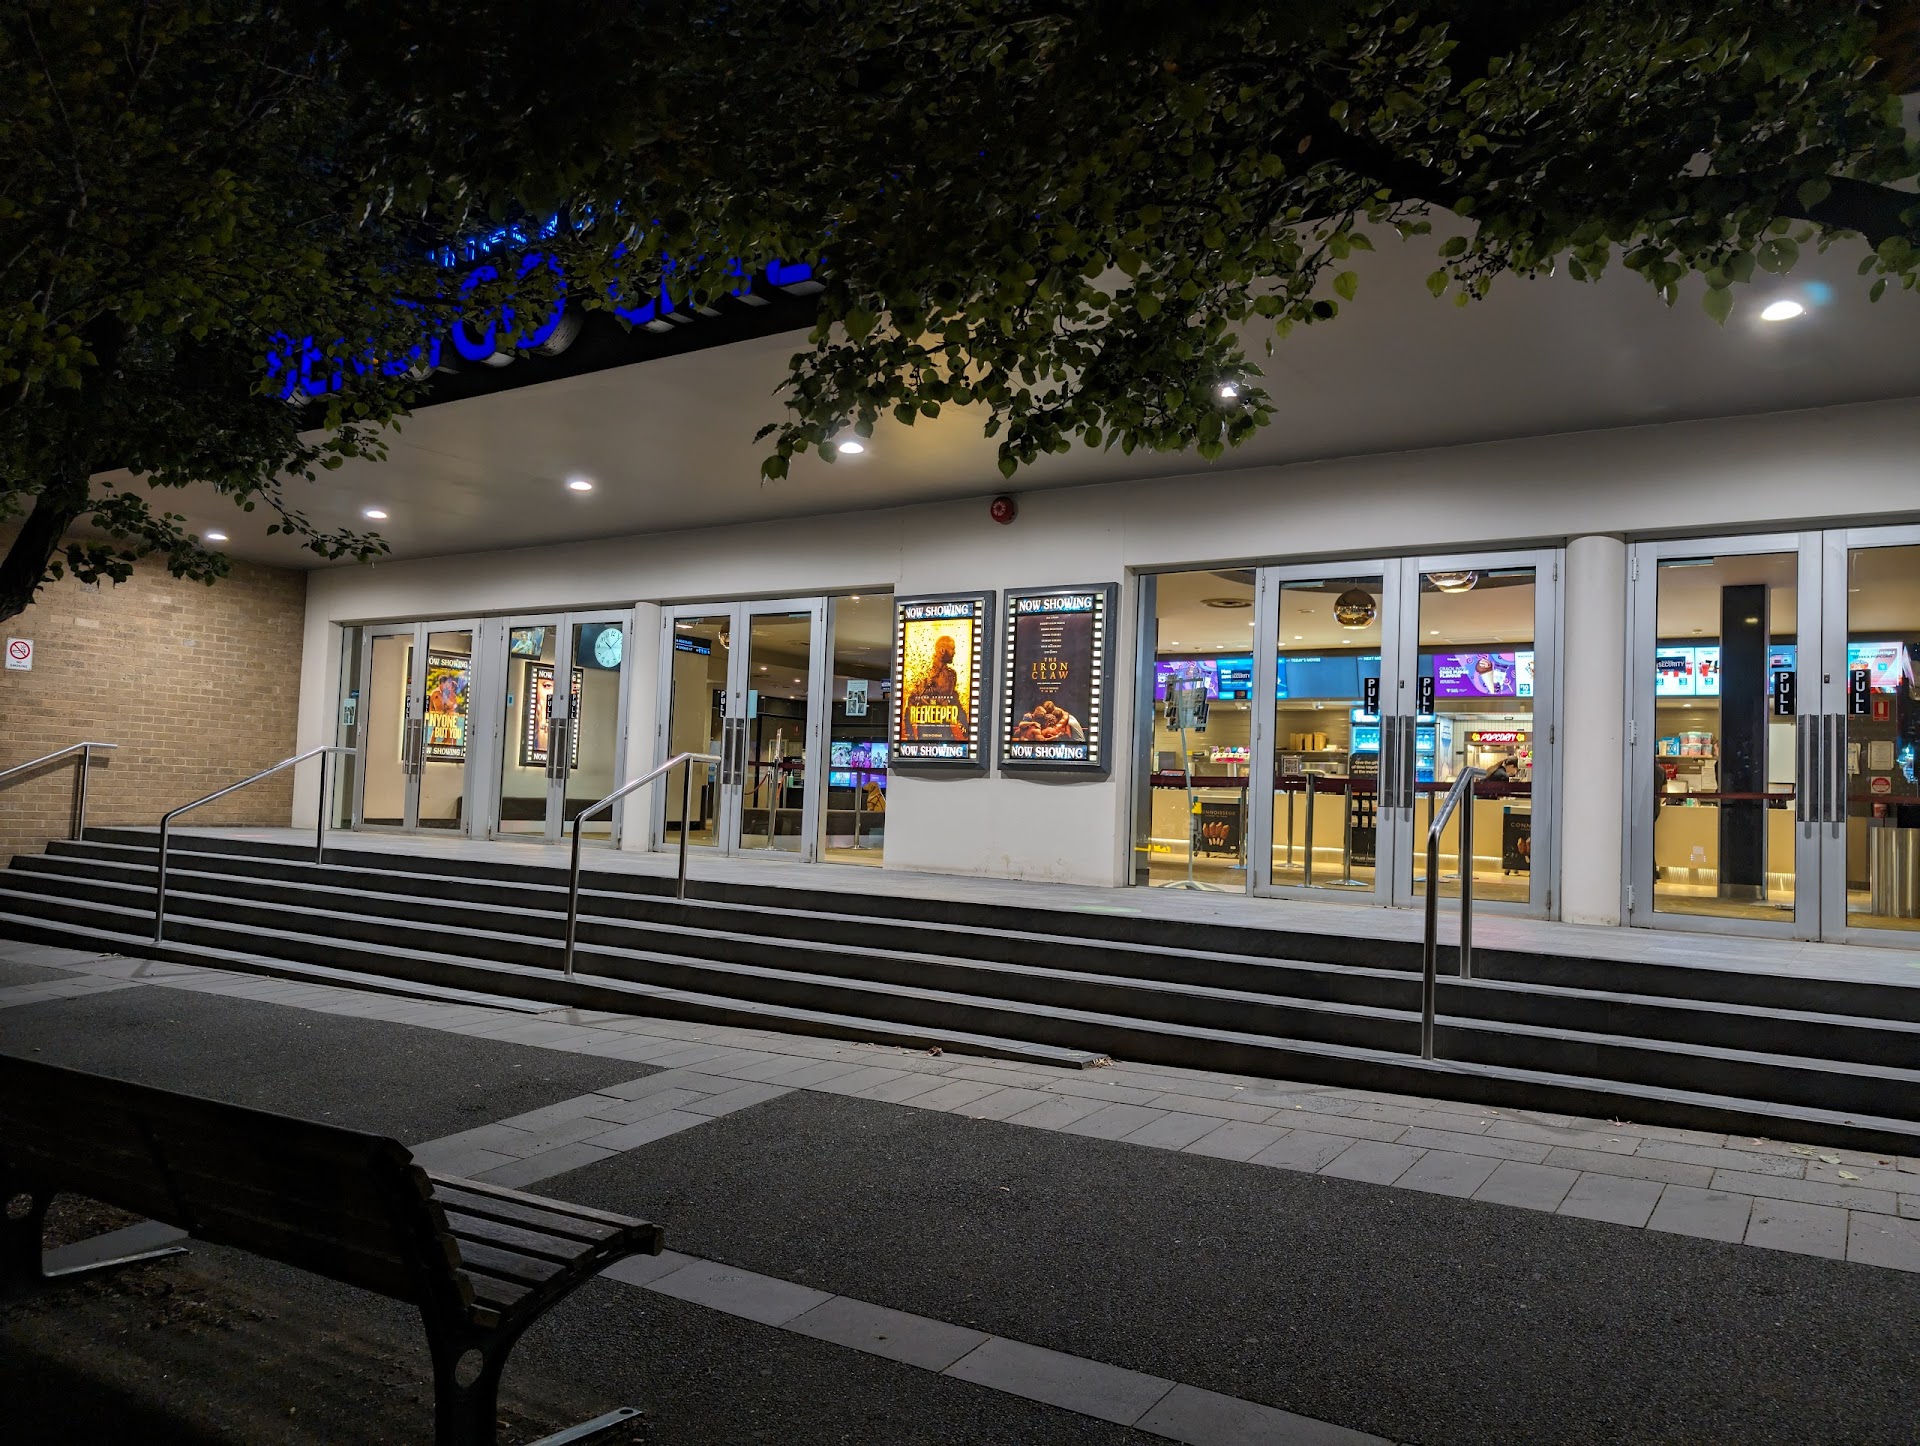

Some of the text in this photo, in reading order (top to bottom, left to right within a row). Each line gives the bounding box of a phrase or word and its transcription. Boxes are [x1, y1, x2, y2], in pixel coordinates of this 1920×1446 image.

[1019, 596, 1092, 612] NOW SHOWING
[905, 603, 969, 619] NOW SHOWING
[428, 656, 468, 669] OW SHOWING
[1032, 662, 1068, 671] IRON
[1657, 660, 1685, 668] SECURITY
[538, 670, 553, 680] NOW
[1032, 671, 1069, 680] CLAW
[1367, 678, 1376, 715] PULL
[1422, 677, 1431, 715] PULL
[1779, 672, 1790, 715] PULL
[1855, 670, 1866, 714] PULL
[910, 705, 959, 725] BEEKEEPER
[434, 727, 462, 740] BUT YOU
[1480, 733, 1517, 742] POPCORN
[433, 747, 461, 756] SHOWING
[533, 753, 548, 761] NOW
[901, 745, 964, 757] NOW SHOWING
[1012, 745, 1084, 759] NOW SHOWING
